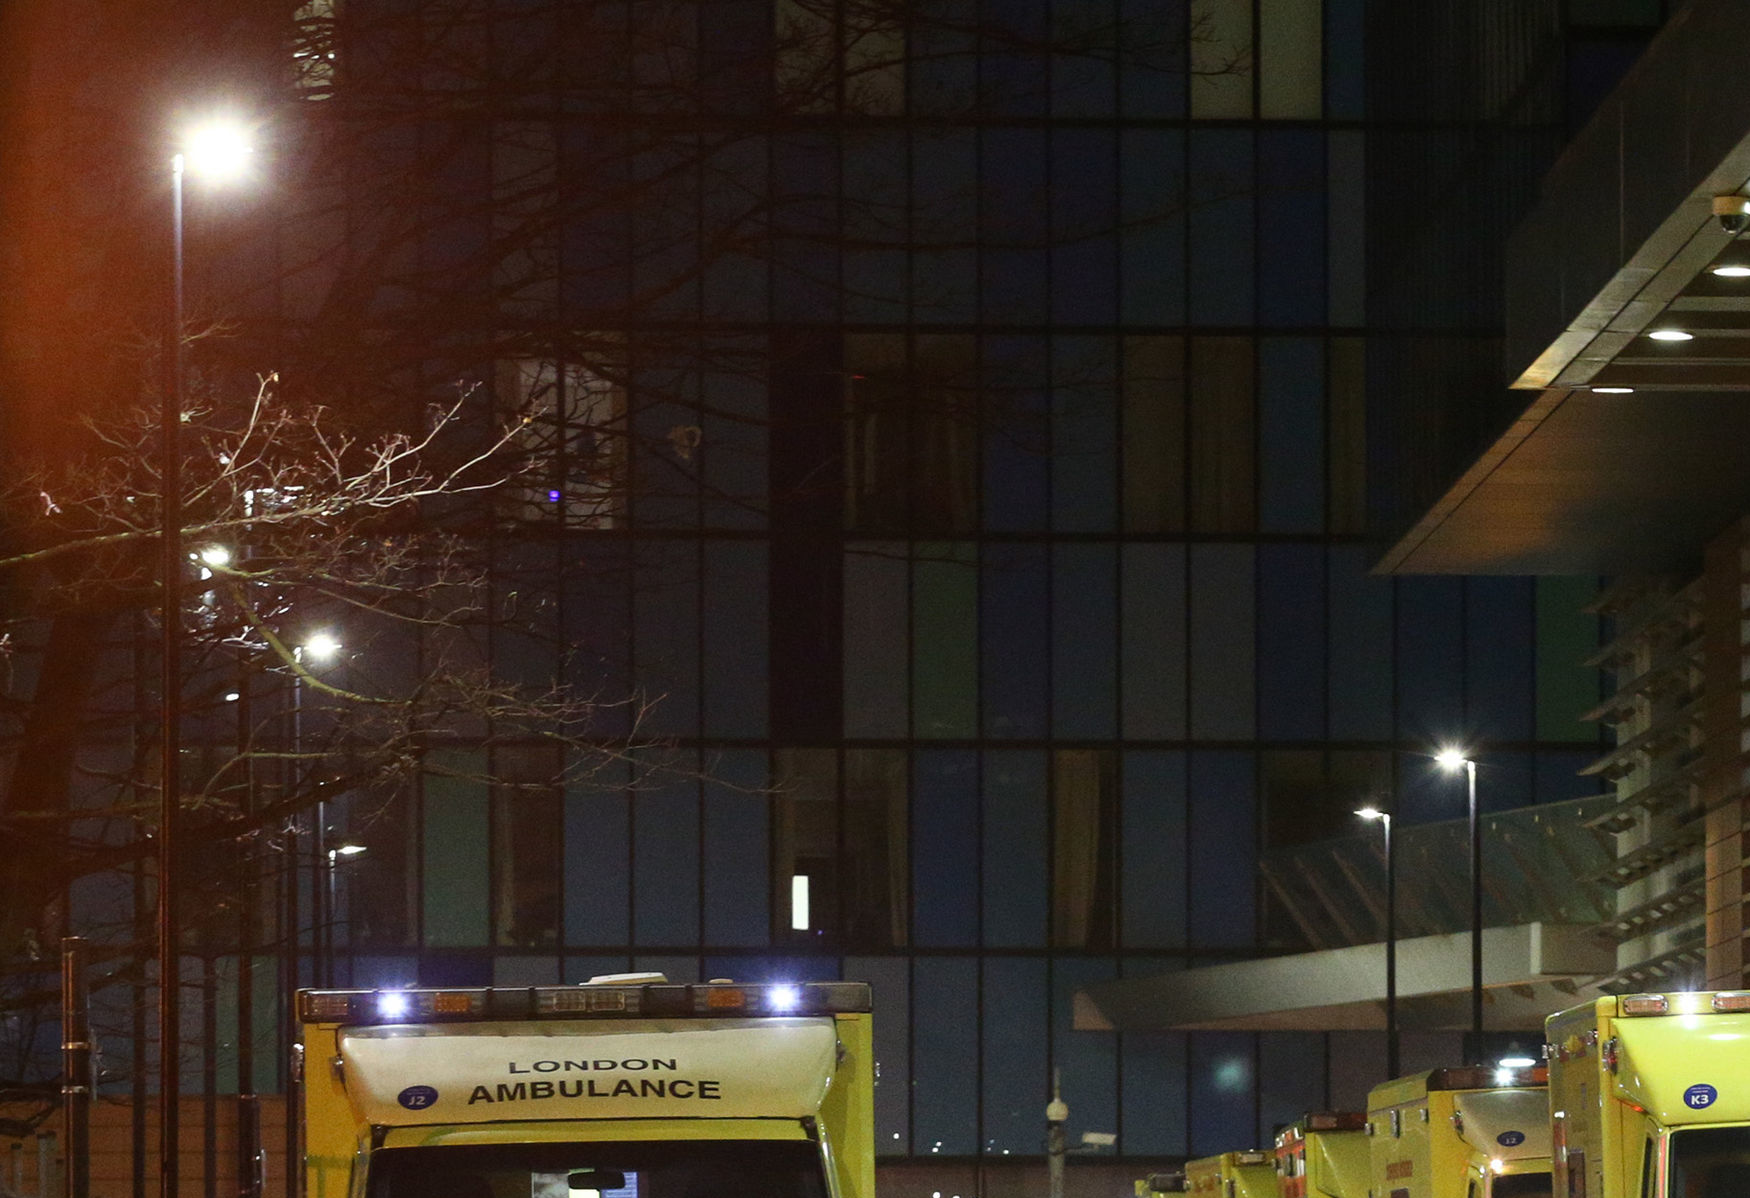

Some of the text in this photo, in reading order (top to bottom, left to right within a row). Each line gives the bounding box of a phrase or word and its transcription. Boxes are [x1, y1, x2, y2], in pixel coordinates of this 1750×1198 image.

[509, 1058, 677, 1074] LONDON
[467, 1079, 721, 1105] AMBULANCE
[408, 1095, 426, 1106] J2
[1690, 1094, 1709, 1105] K3
